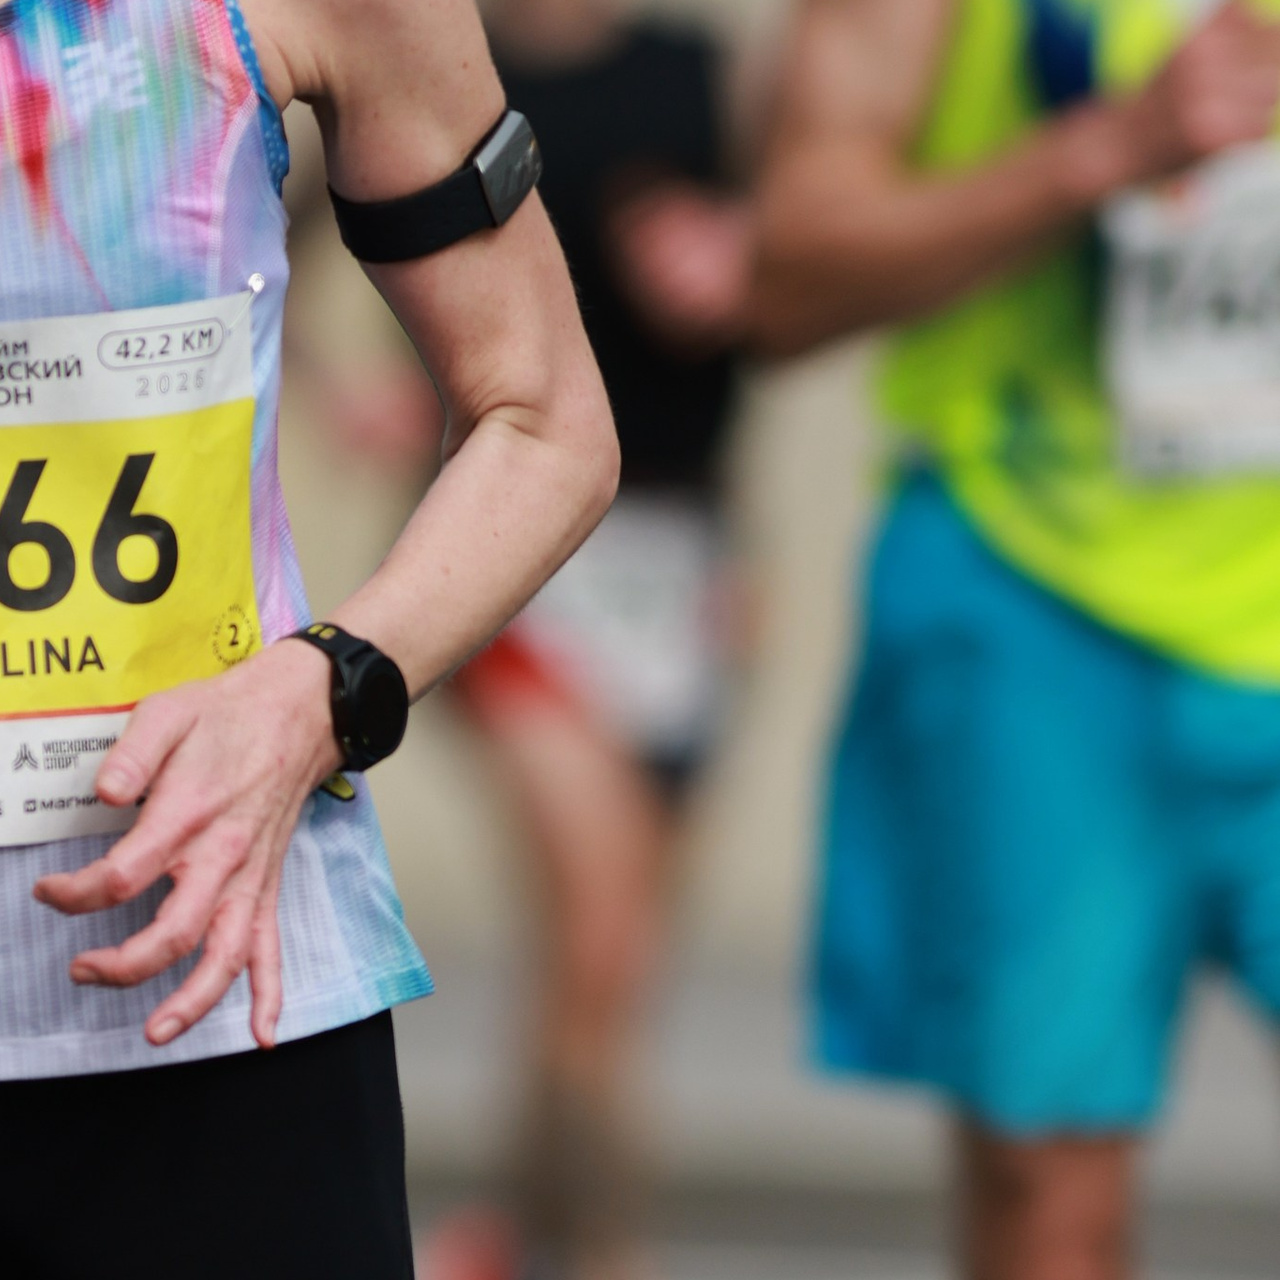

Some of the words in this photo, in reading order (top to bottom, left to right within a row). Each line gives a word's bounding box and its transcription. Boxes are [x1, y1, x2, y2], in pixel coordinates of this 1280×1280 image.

[116, 334, 171, 359] 42,2
[228, 622, 239, 647] 2
[40, 794, 100, 811] магни
